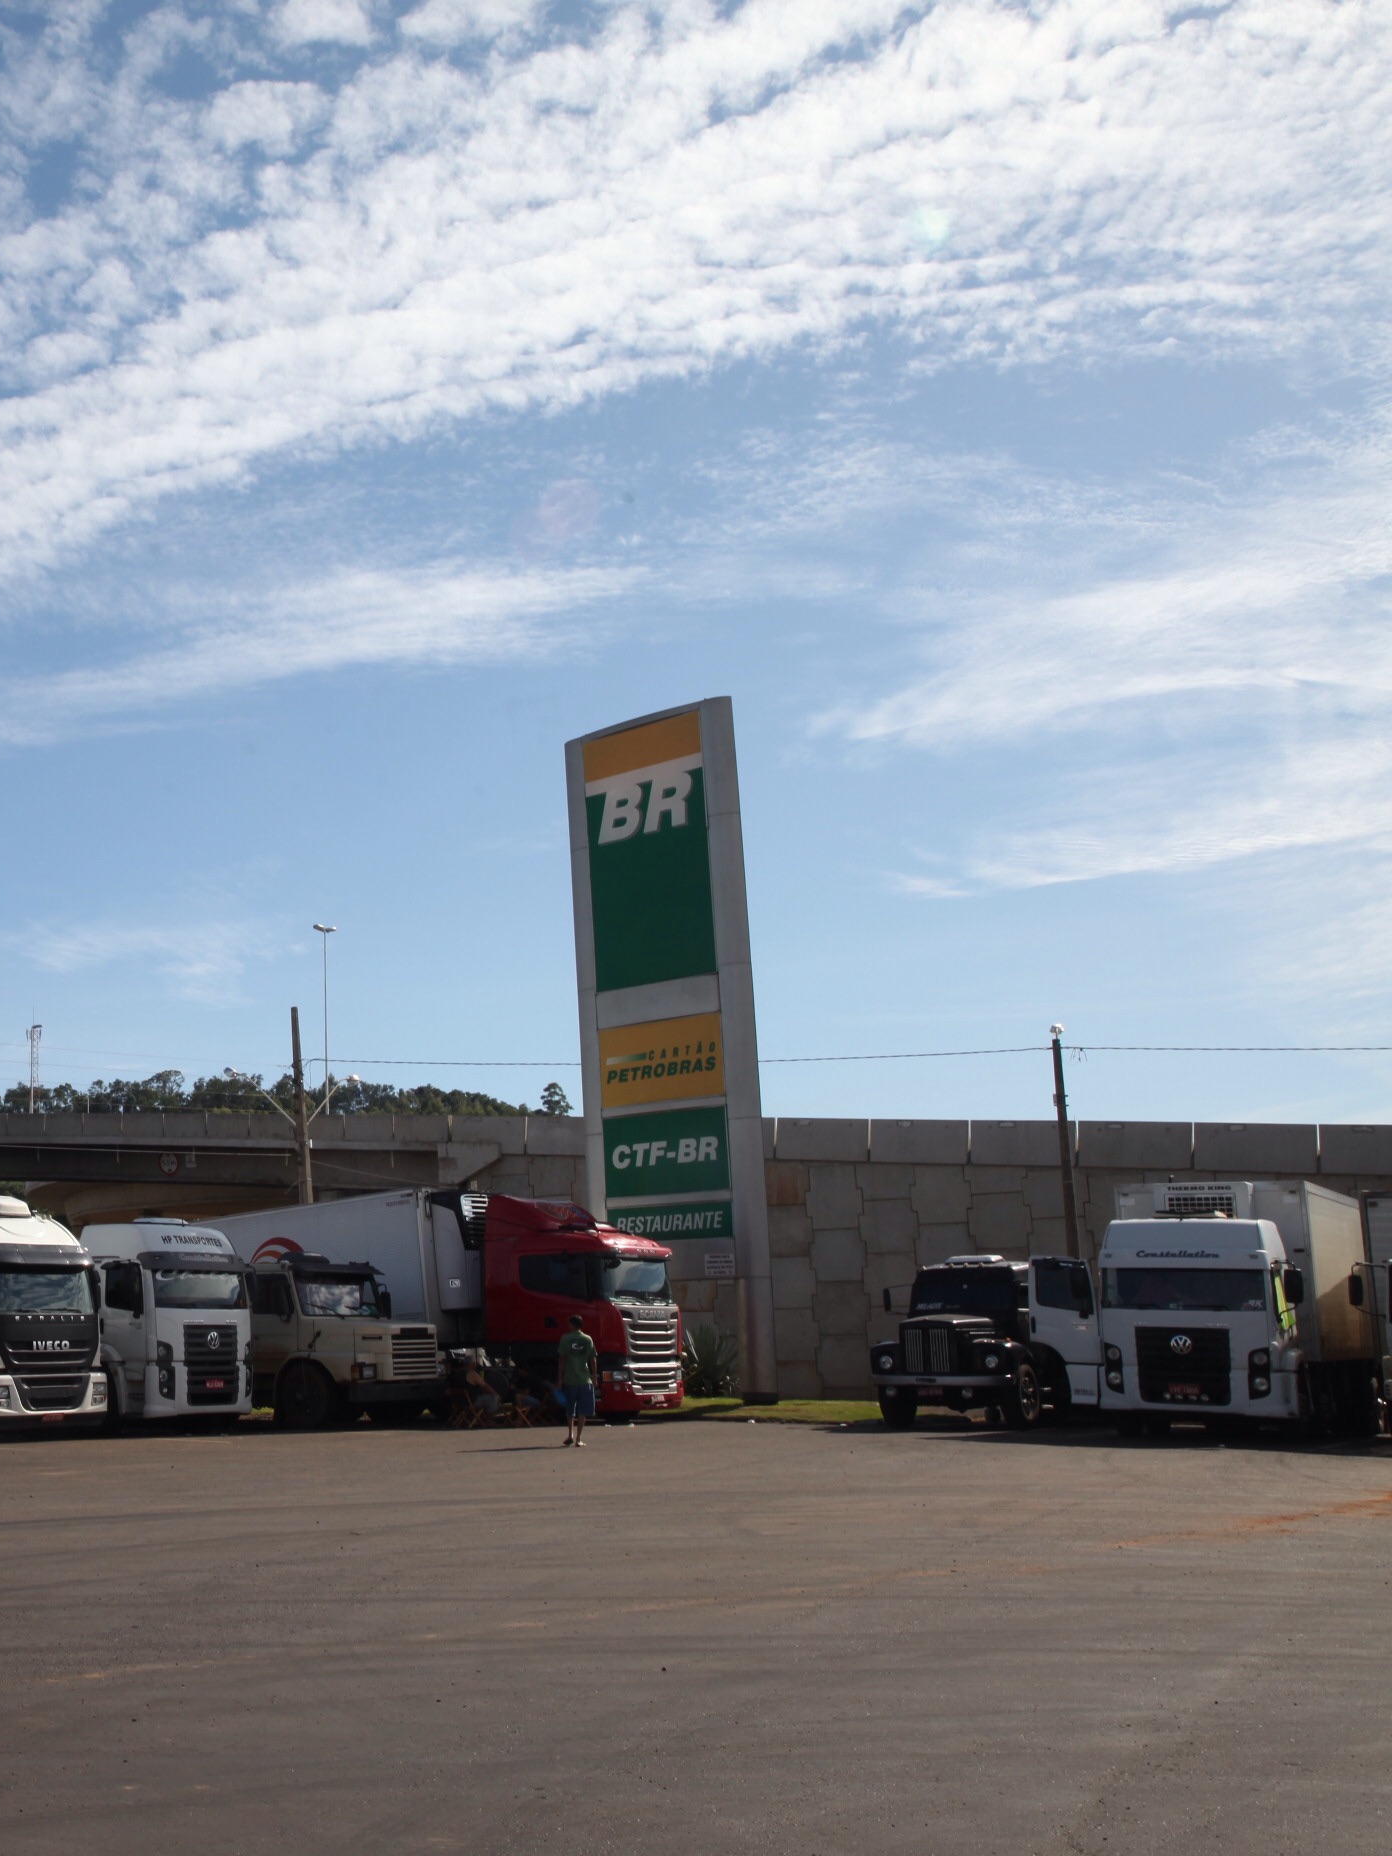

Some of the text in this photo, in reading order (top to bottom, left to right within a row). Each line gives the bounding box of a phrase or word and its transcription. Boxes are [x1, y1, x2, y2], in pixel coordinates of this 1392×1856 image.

[598, 768, 692, 846] BR
[649, 1041, 715, 1060] CARTÃO
[607, 1057, 716, 1084] PETROBRAS
[612, 1136, 718, 1169] CTF-BR
[617, 1210, 723, 1233] RESTAURANTE
[173, 1236, 222, 1247] TRANSPORTES
[1136, 1250, 1219, 1258] Constellation
[32, 1340, 70, 1351] IVECO
